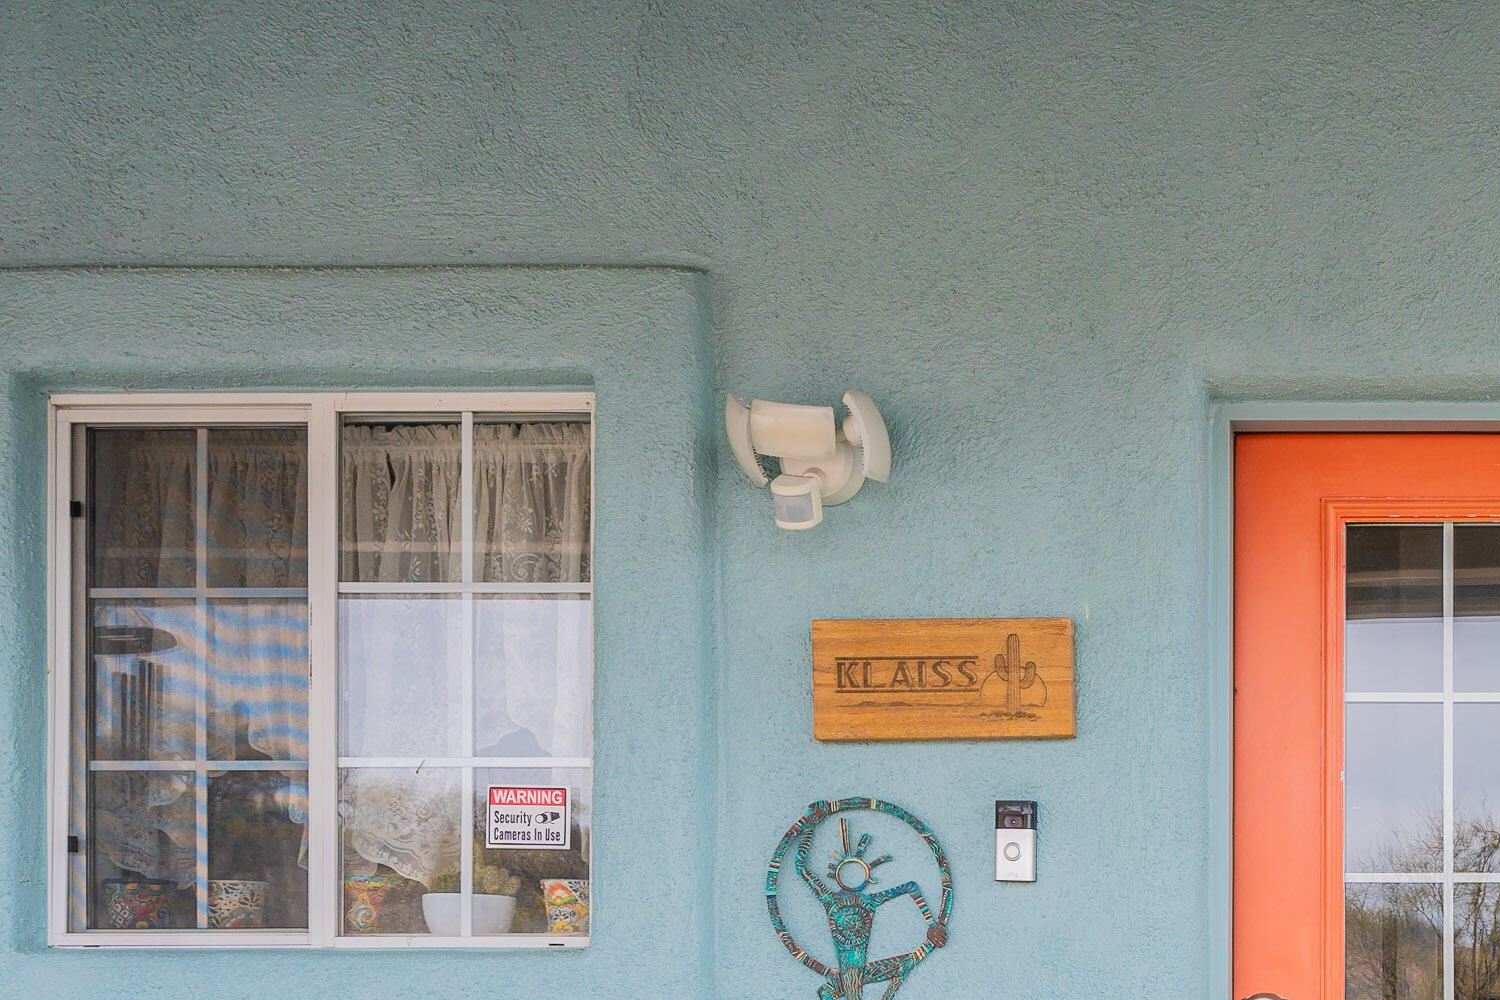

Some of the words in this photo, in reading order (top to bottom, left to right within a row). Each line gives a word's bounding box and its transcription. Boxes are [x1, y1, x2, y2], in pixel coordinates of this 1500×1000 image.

[836, 660, 978, 688] KLAISS
[493, 789, 563, 804] WARNING
[494, 811, 532, 826] Security
[493, 827, 531, 841] Cameras
[534, 828, 543, 841] In
[545, 828, 561, 841] Use
